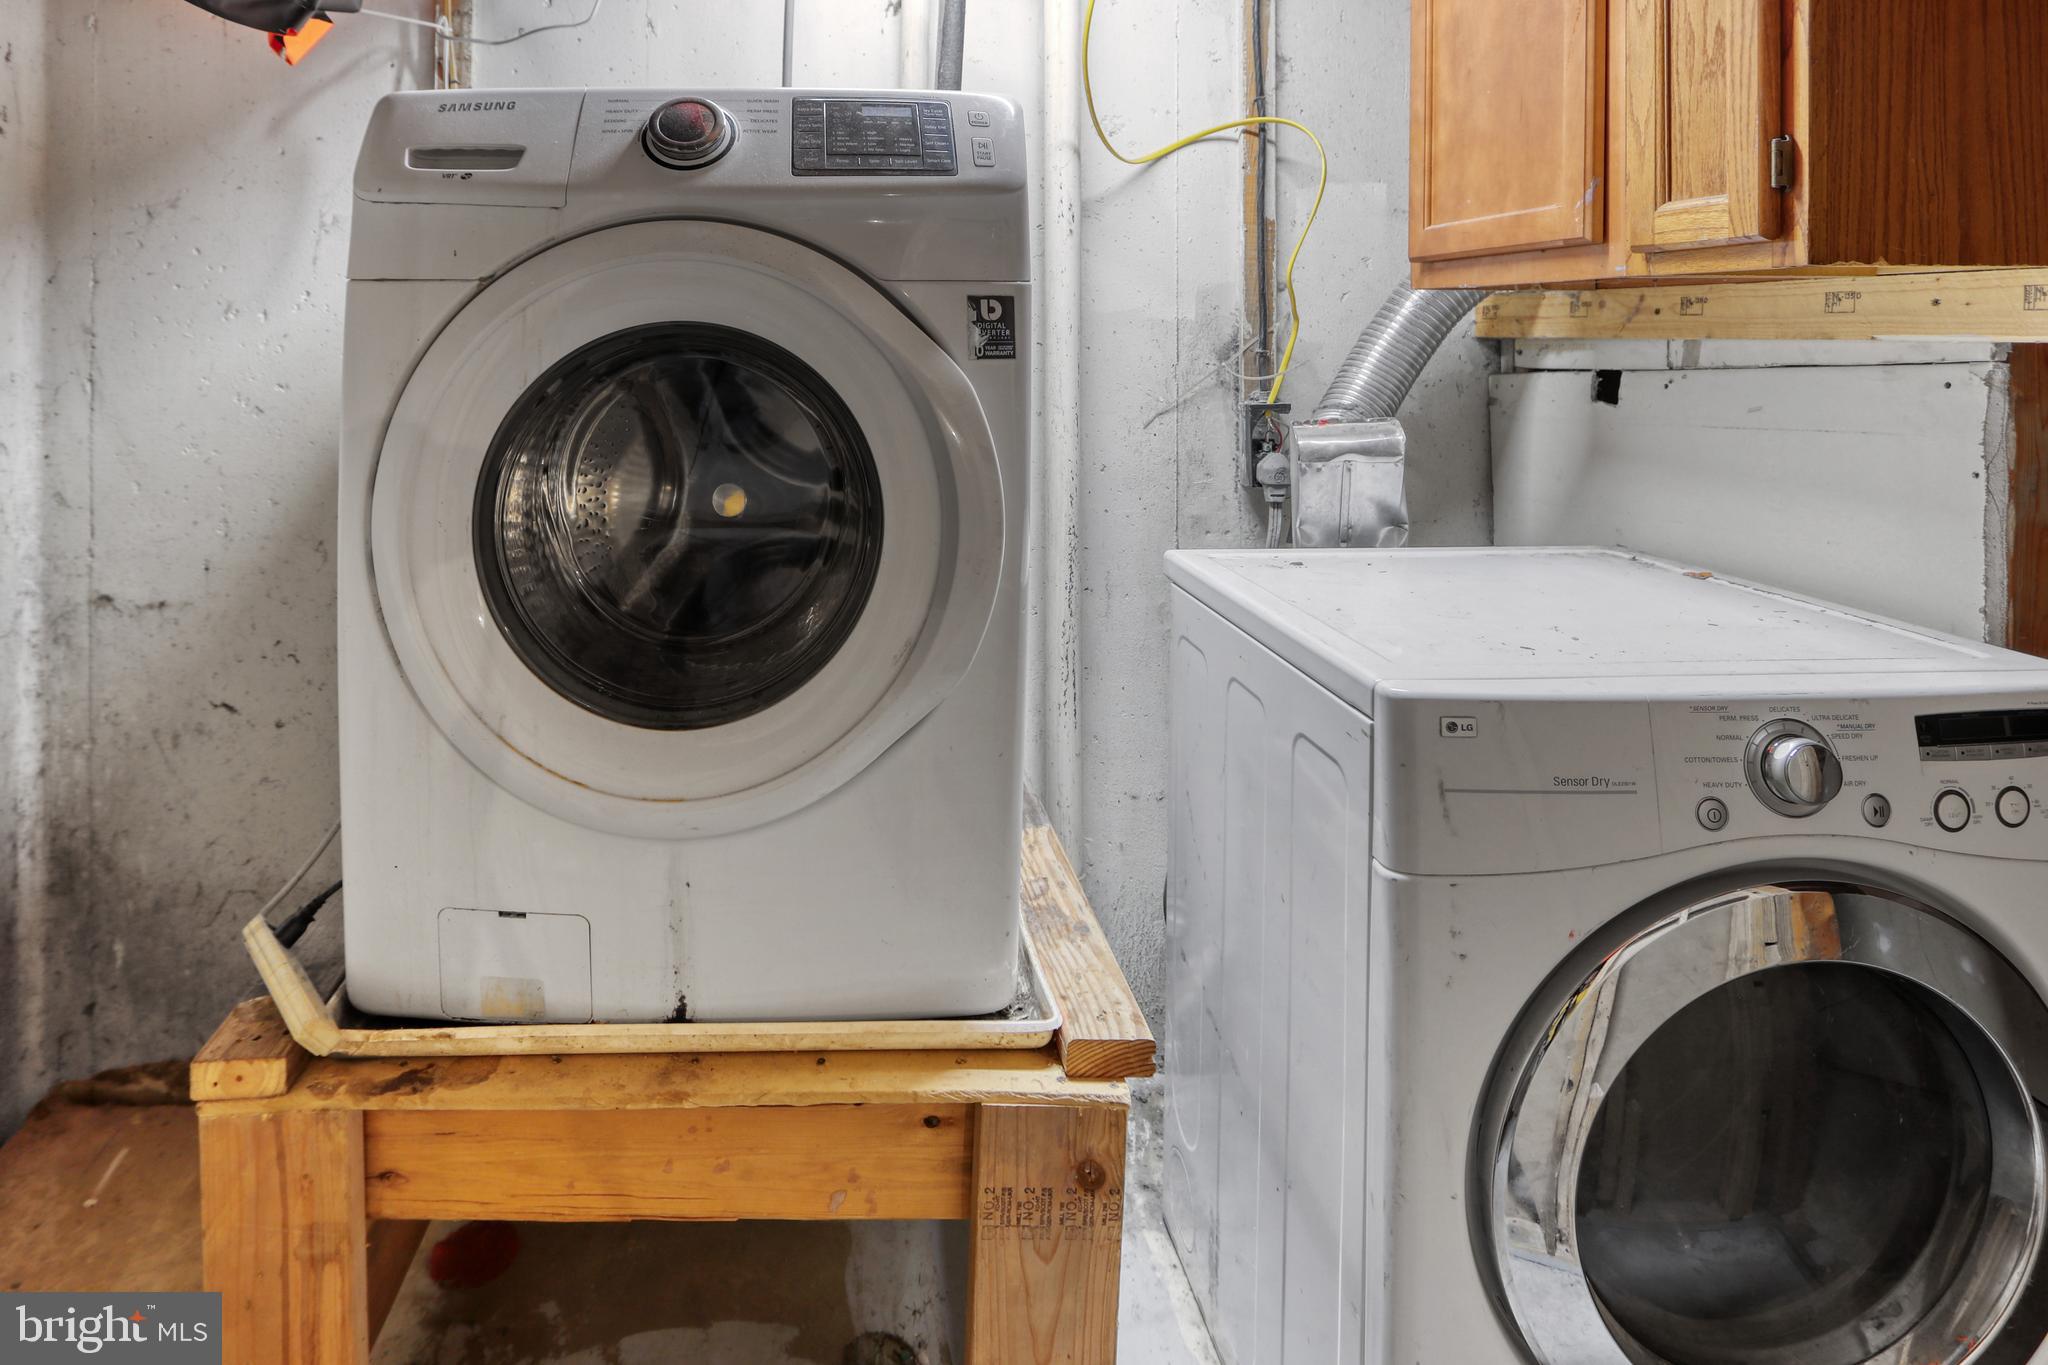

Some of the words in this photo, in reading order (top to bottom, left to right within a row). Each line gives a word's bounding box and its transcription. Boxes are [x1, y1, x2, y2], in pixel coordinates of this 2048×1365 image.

[438, 101, 516, 113] SAMSUNG
[976, 346, 984, 357] 0
[1461, 723, 1474, 732] LG
[1553, 776, 1590, 787] Sensor
[1592, 776, 1610, 789] Dry
